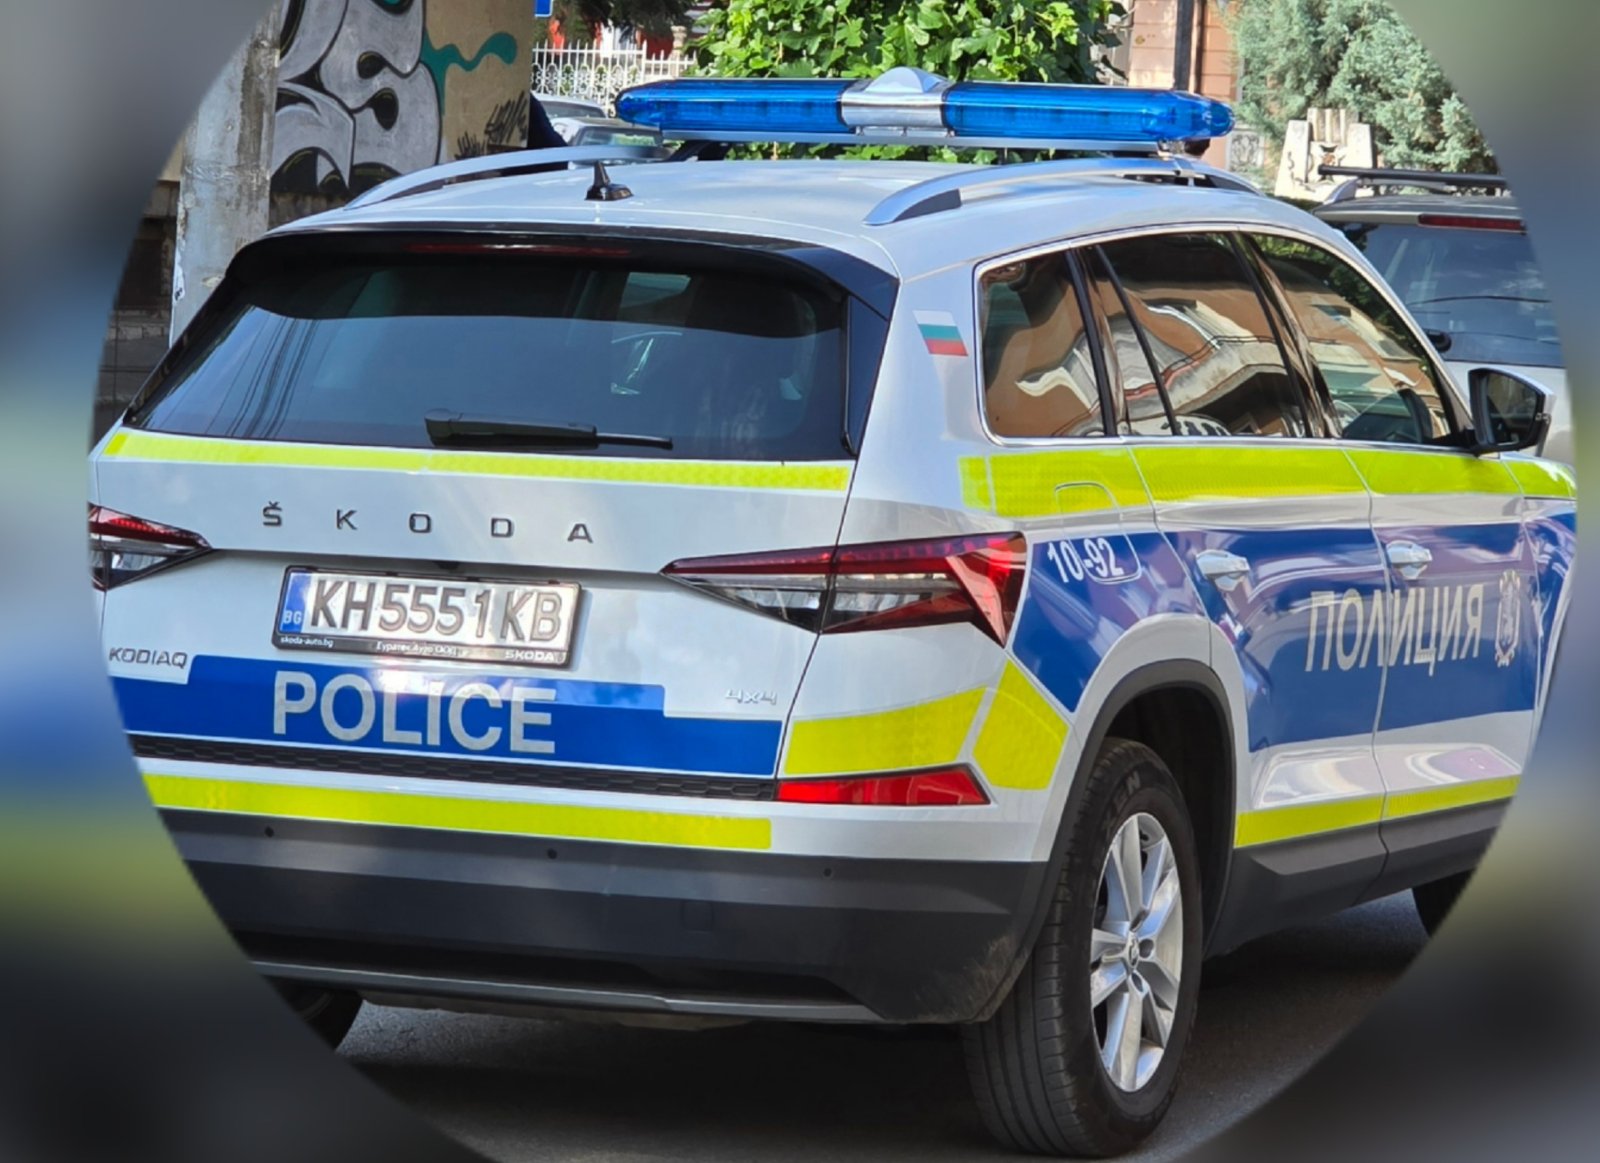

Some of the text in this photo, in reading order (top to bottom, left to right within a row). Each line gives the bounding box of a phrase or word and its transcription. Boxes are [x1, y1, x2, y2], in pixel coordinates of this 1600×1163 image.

[262, 501, 594, 544] ŠKODA
[1047, 537, 1125, 583] 10-92
[282, 609, 303, 625] BG
[1304, 583, 1484, 677] ПОЛИЦИЯ
[108, 647, 188, 670] KODIAQ
[273, 669, 557, 756] POLICE
